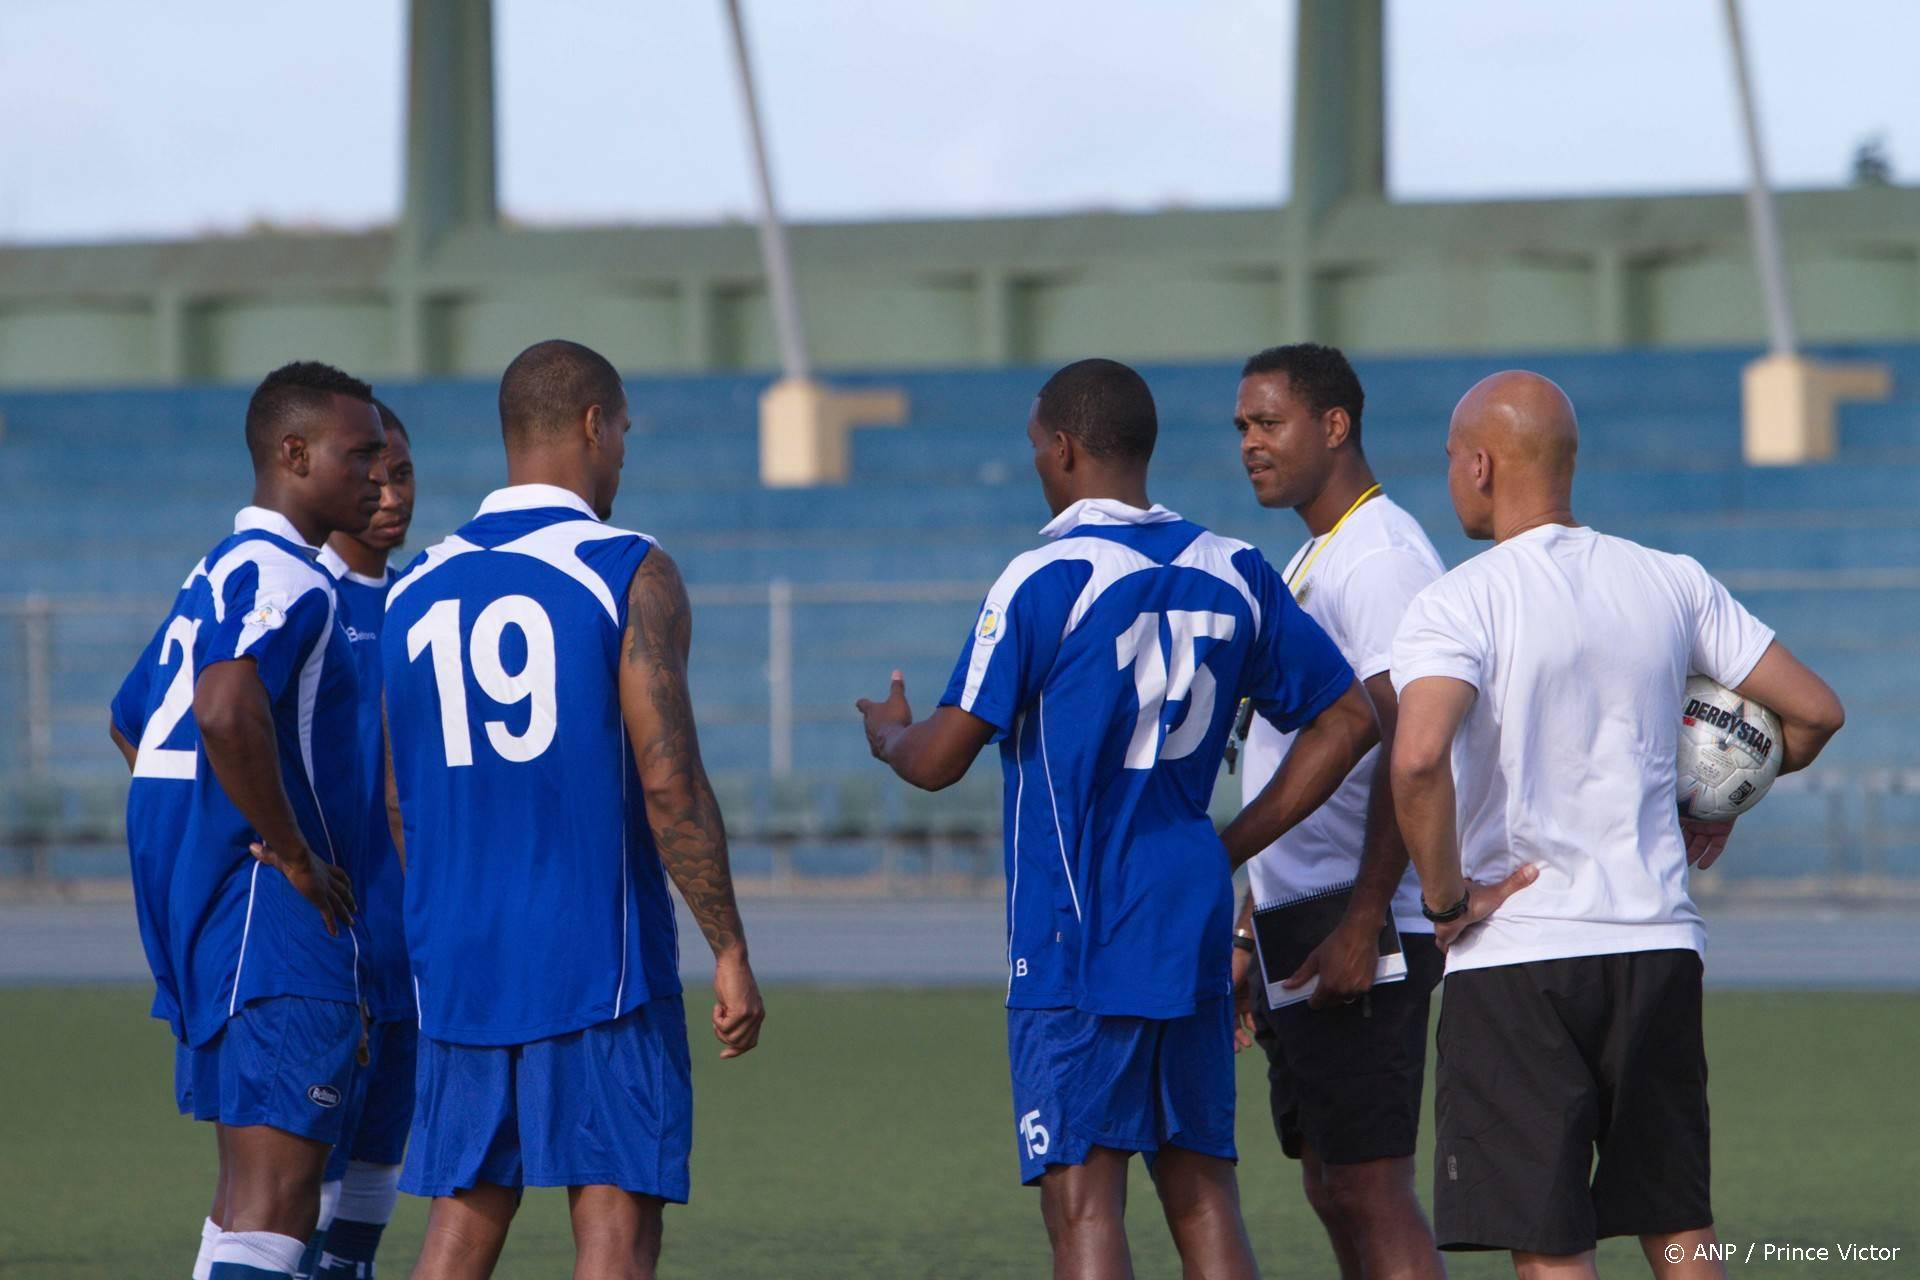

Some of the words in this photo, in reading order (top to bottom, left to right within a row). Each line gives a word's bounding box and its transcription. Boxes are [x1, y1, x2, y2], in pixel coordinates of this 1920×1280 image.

[131, 614, 204, 781] 2
[406, 594, 558, 768] 19
[1115, 609, 1237, 769] 15
[1684, 698, 1773, 758] DERBYSTAR
[1020, 1109, 1050, 1160] 15
